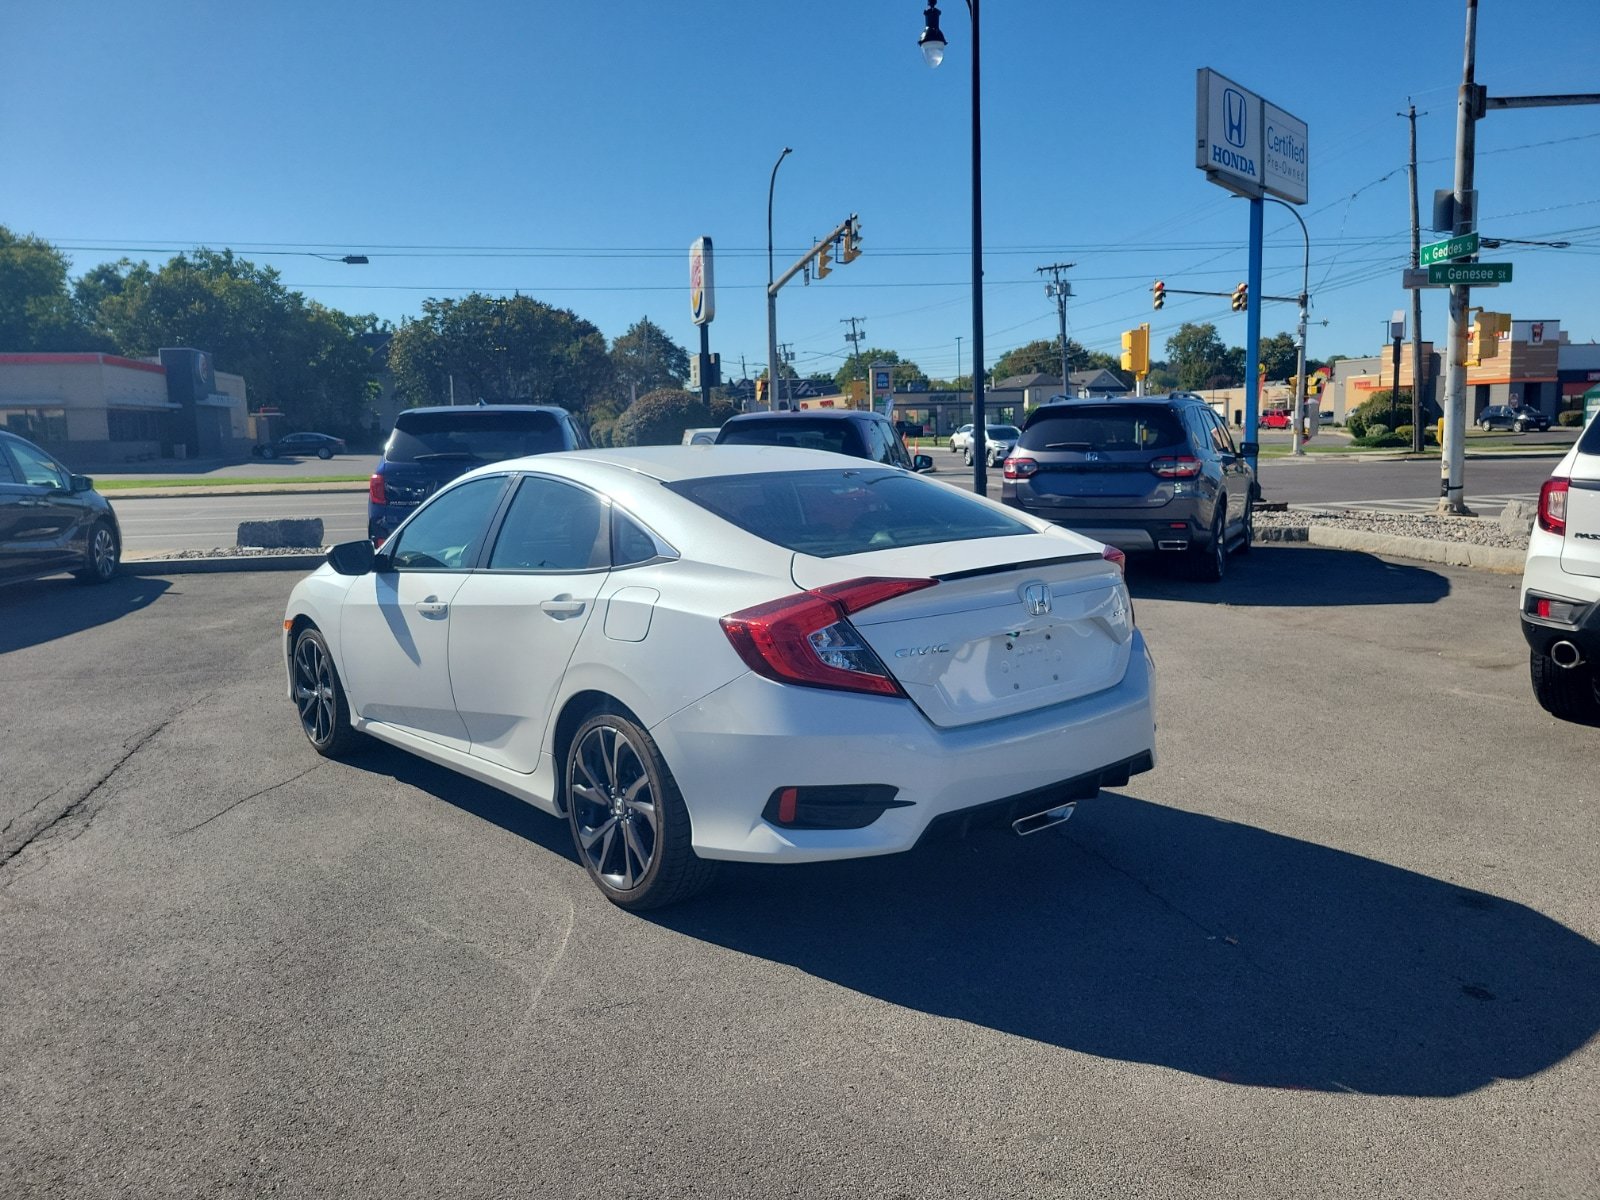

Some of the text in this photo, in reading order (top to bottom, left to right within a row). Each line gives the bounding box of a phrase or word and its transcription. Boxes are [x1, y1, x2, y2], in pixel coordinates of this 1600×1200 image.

[1267, 126, 1304, 164] Certified
[1212, 145, 1256, 176] HONDA
[1267, 153, 1304, 182] Pre-Owned
[1424, 241, 1473, 261] N Geddes St
[1435, 268, 1506, 279] W Genesee St
[895, 643, 950, 658] CIVIC
